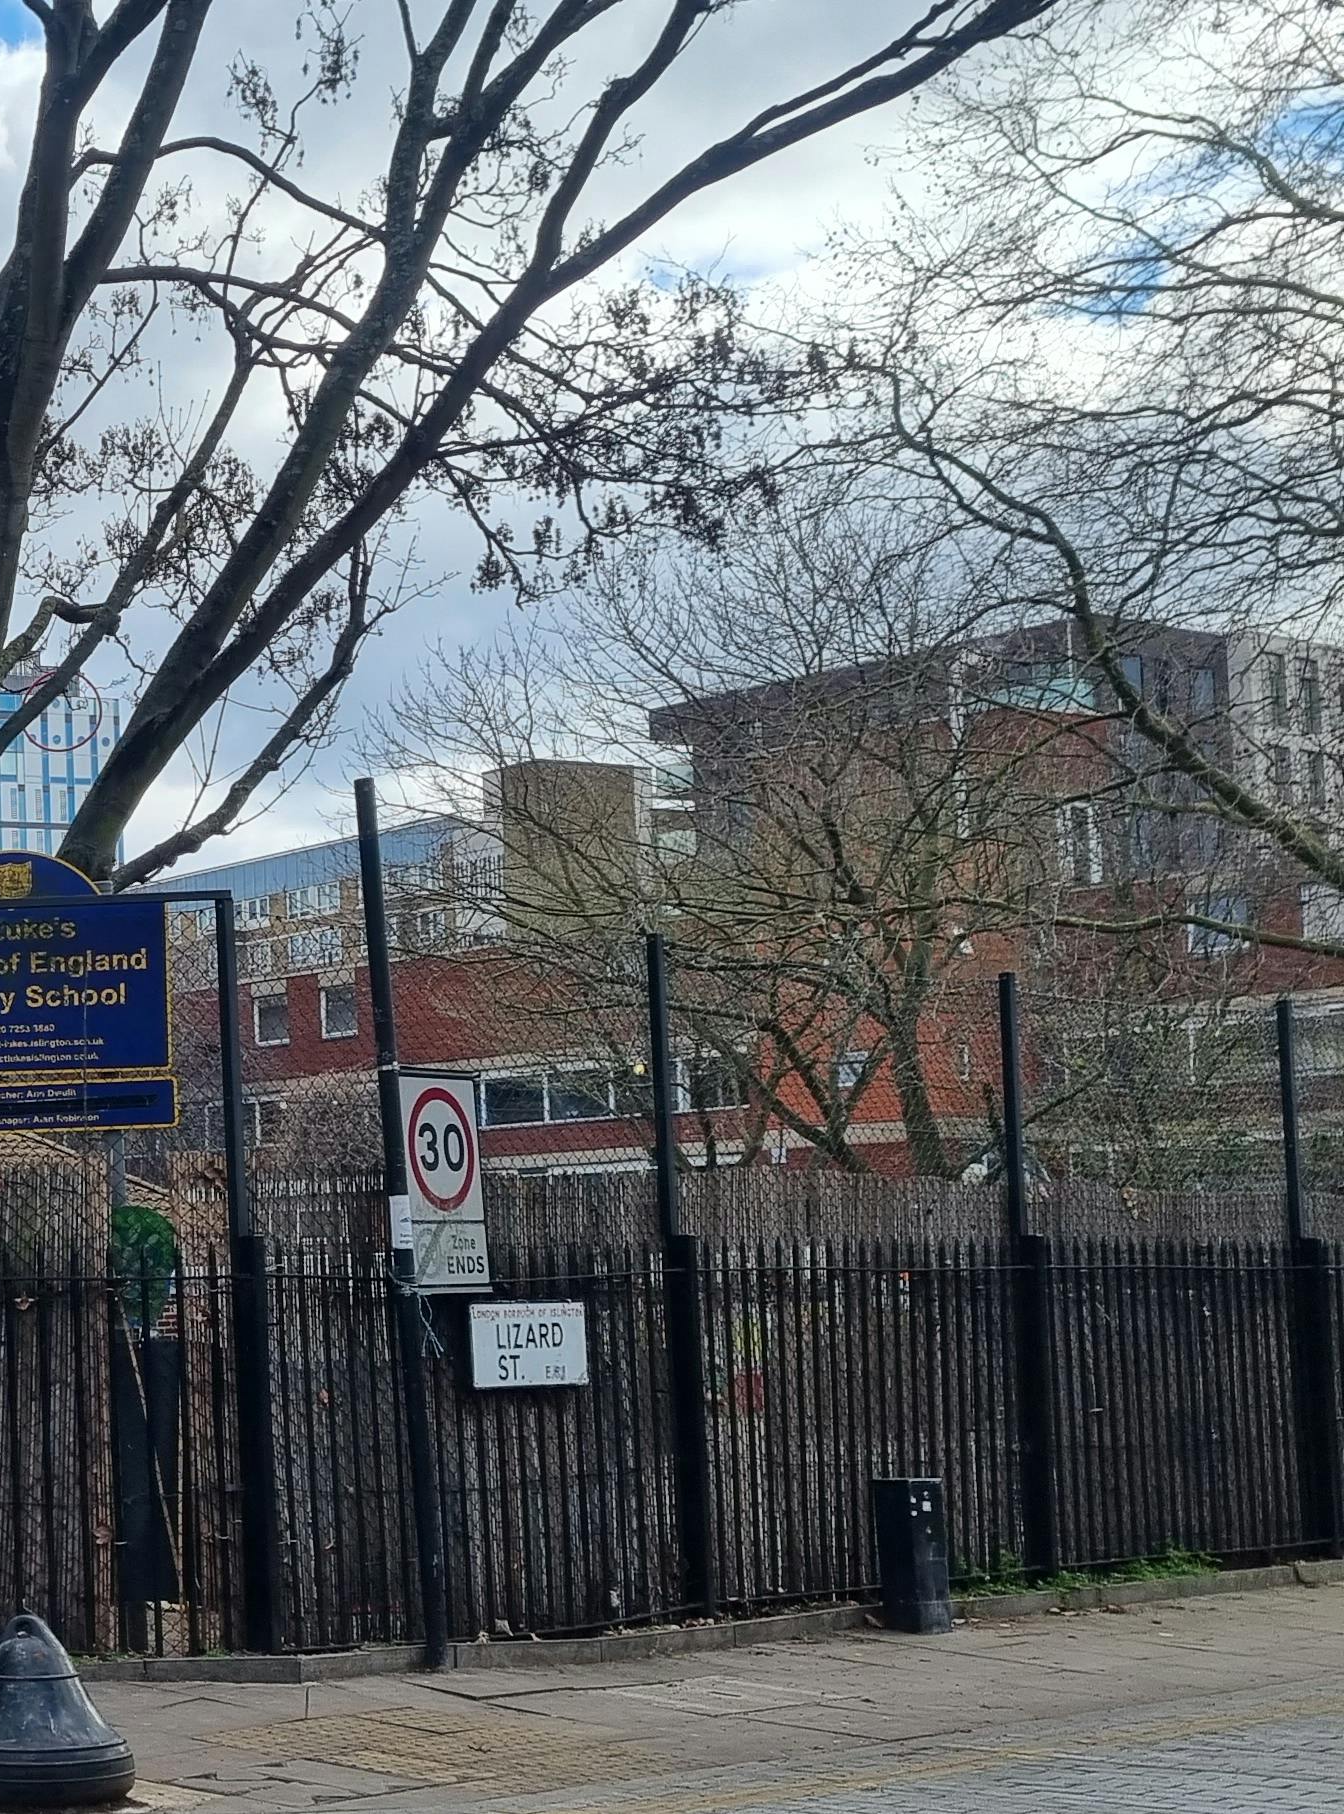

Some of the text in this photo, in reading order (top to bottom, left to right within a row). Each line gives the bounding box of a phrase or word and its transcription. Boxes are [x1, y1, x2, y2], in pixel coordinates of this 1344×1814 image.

[29, 947, 148, 978] England
[25, 982, 126, 1008] School
[418, 1122, 465, 1172] 30
[451, 1235, 476, 1250] Zone
[447, 1255, 485, 1275] ENDS
[472, 1307, 584, 1319] LONDON BOROUGH OF ISLINGTON
[496, 1322, 564, 1349] LIZARD
[498, 1354, 526, 1381] ST.
